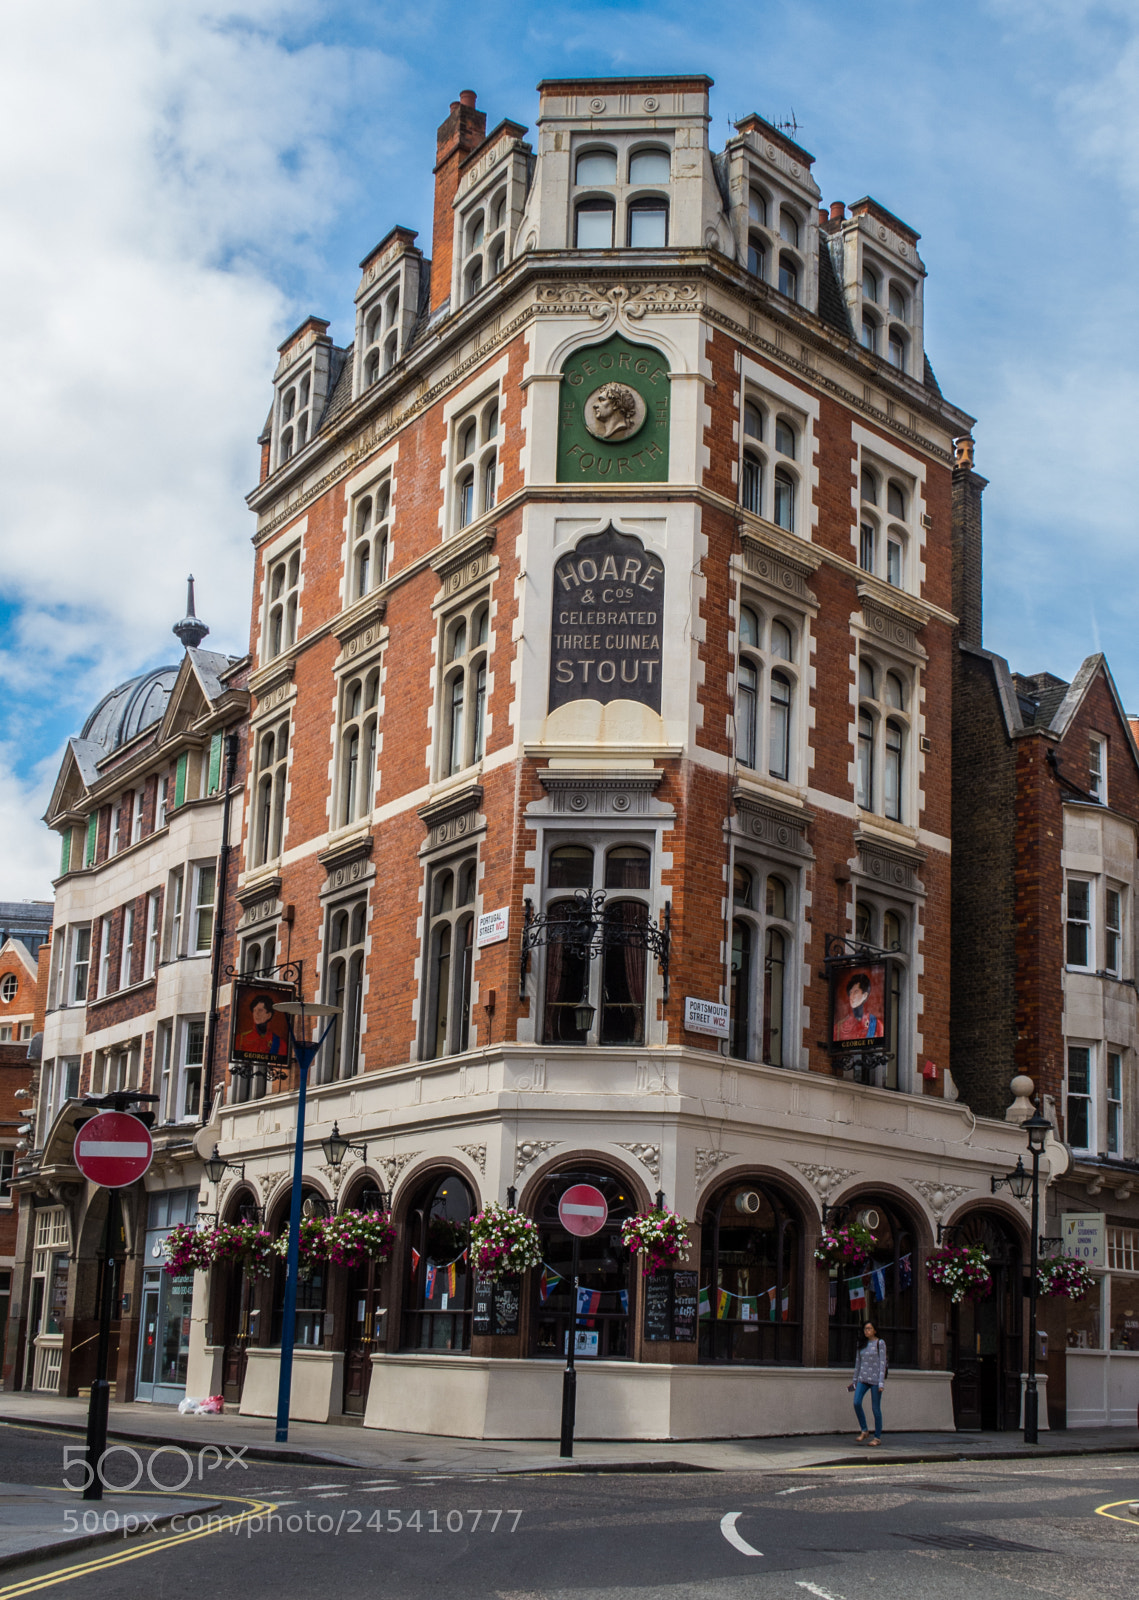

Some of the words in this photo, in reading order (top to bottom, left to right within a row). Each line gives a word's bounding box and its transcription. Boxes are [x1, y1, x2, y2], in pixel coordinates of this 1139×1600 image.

[567, 352, 666, 386] GEORGE
[563, 401, 575, 430] THE
[656, 396, 668, 429] THE
[565, 441, 663, 475] FOURTH
[556, 554, 663, 592] HOARE
[580, 589, 596, 604] &
[559, 611, 657, 625] CELEBRATED
[554, 634, 601, 650] THREE
[555, 659, 660, 683] STOUT
[480, 912, 501, 926] PORTUGAL
[480, 924, 495, 936] STREET
[496, 921, 505, 930] WC2
[690, 1001, 727, 1016] PORTSMOUTH
[690, 1012, 709, 1023] STREET
[714, 1017, 725, 1027] WC2
[244, 1052, 269, 1060] GEORGE
[1067, 1246, 1098, 1257] SHOP
